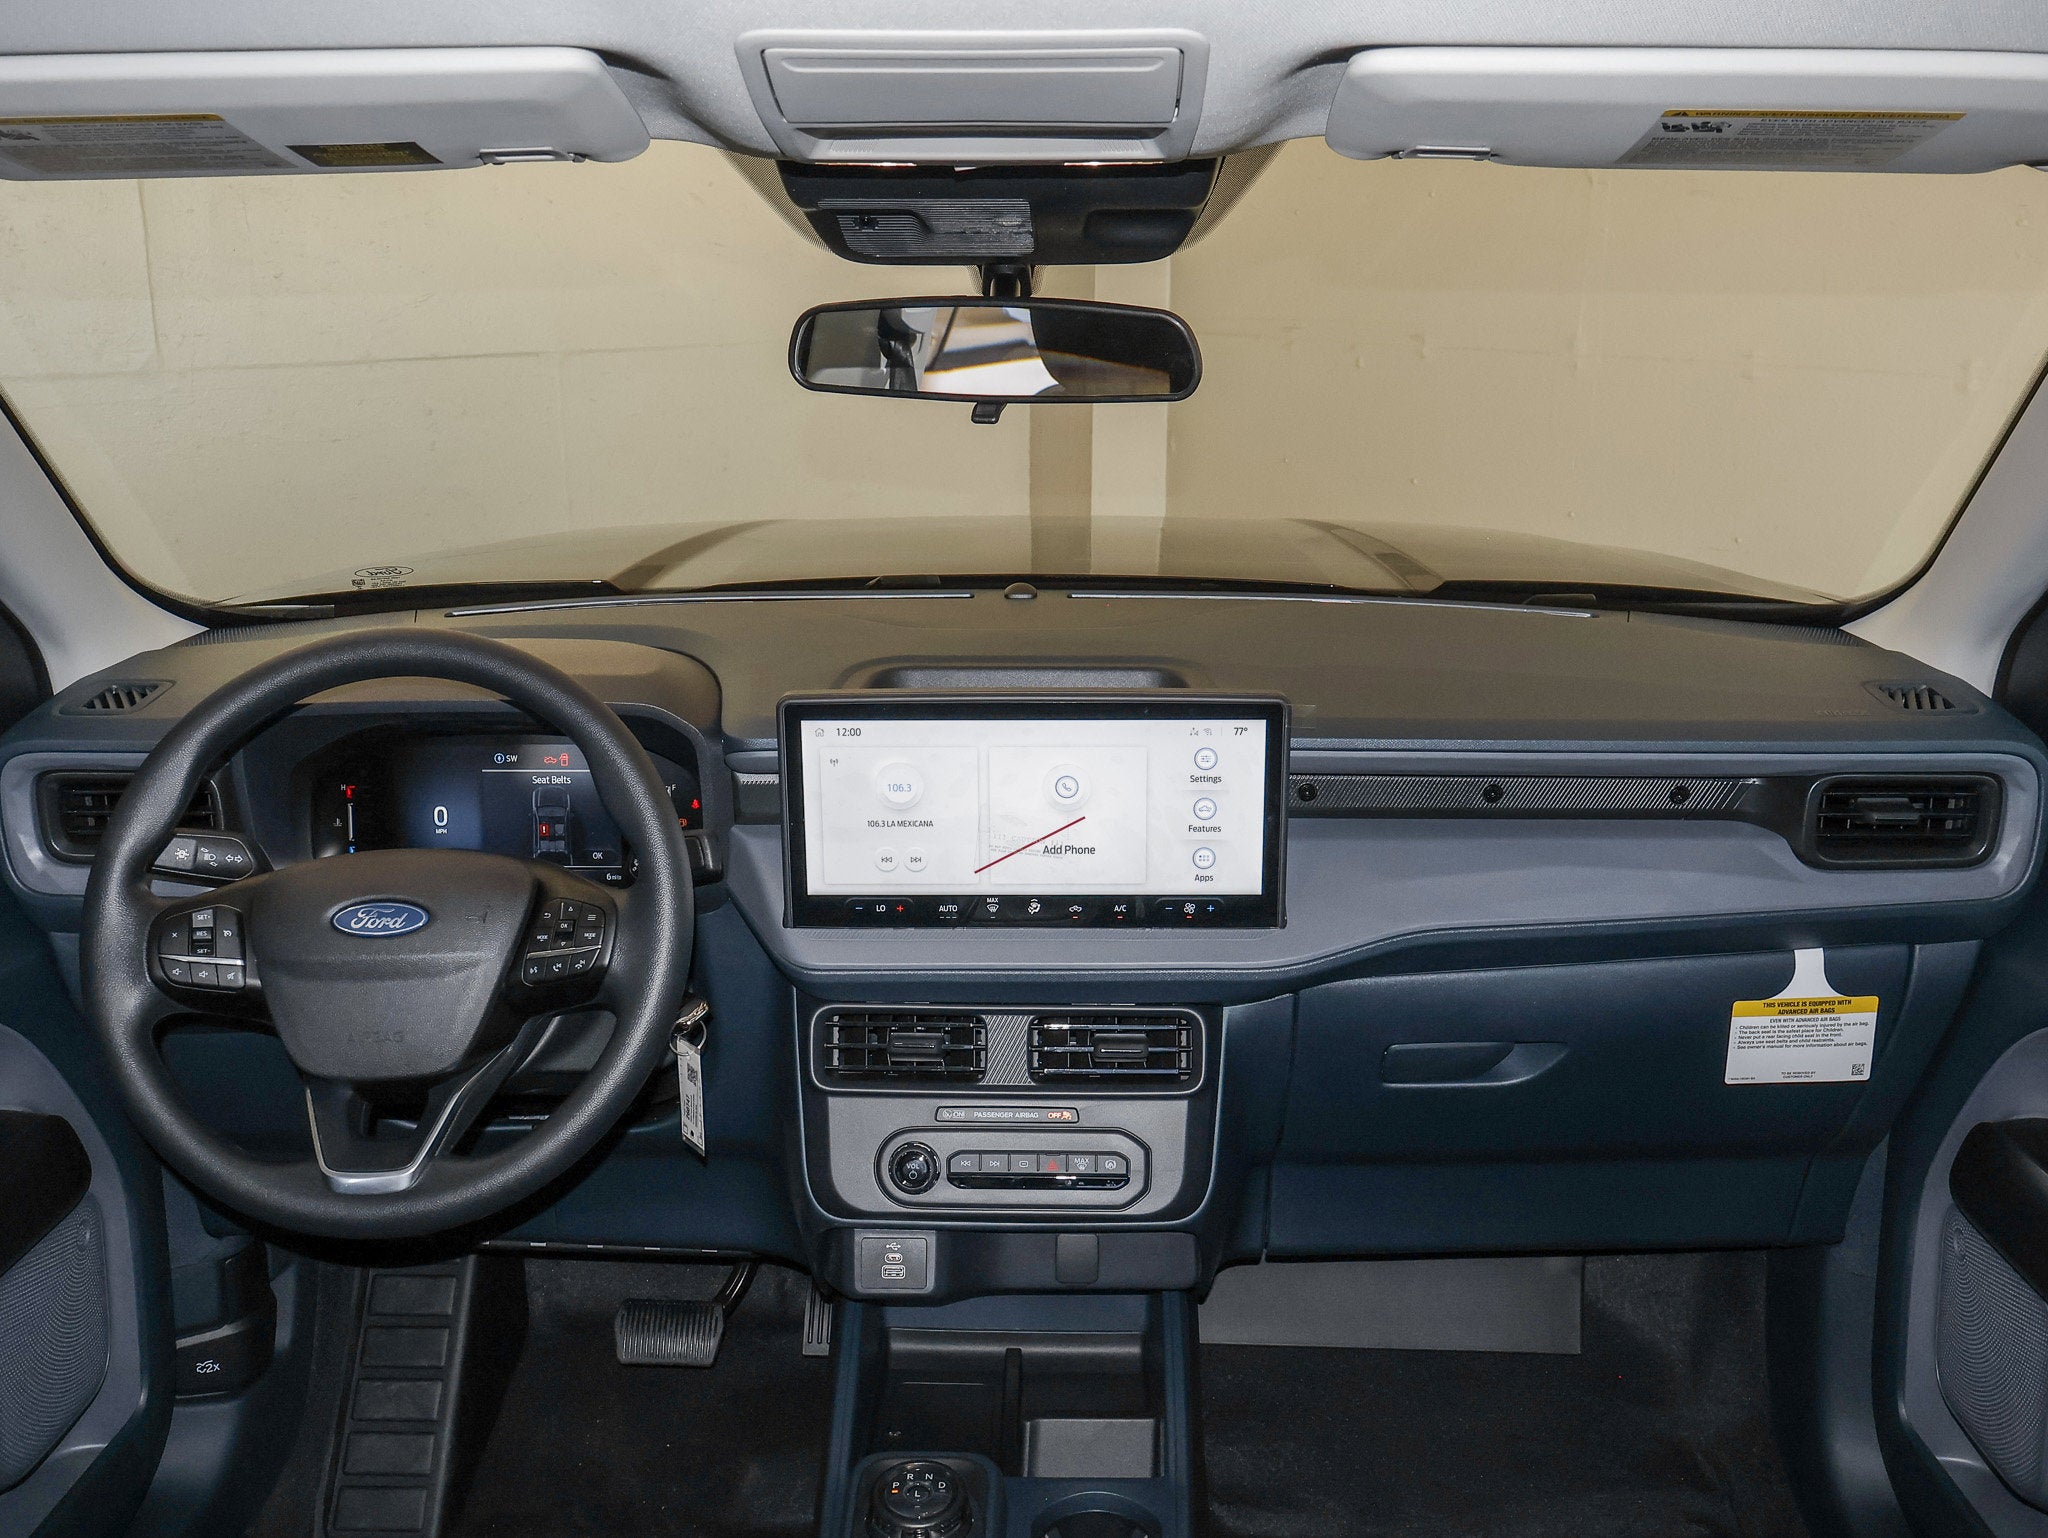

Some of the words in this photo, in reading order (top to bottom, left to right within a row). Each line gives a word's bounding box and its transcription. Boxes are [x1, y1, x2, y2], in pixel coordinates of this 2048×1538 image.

[836, 728, 861, 737] 12:00
[1234, 727, 1248, 736] 77°
[506, 755, 518, 763] SW
[532, 776, 550, 784] Seat
[552, 776, 571, 784] Belts
[1190, 775, 1222, 784] Settings
[888, 784, 912, 792] 106.3
[433, 806, 448, 827] 0
[868, 820, 886, 828] 106.3
[887, 820, 896, 828] LA
[897, 820, 934, 828] MEXICANA
[1188, 825, 1222, 833] Features
[1043, 846, 1062, 855] Add
[1065, 846, 1096, 855] Phone
[1195, 874, 1214, 883] Apps
[1114, 904, 1127, 912] A/C
[350, 908, 408, 929] Ford
